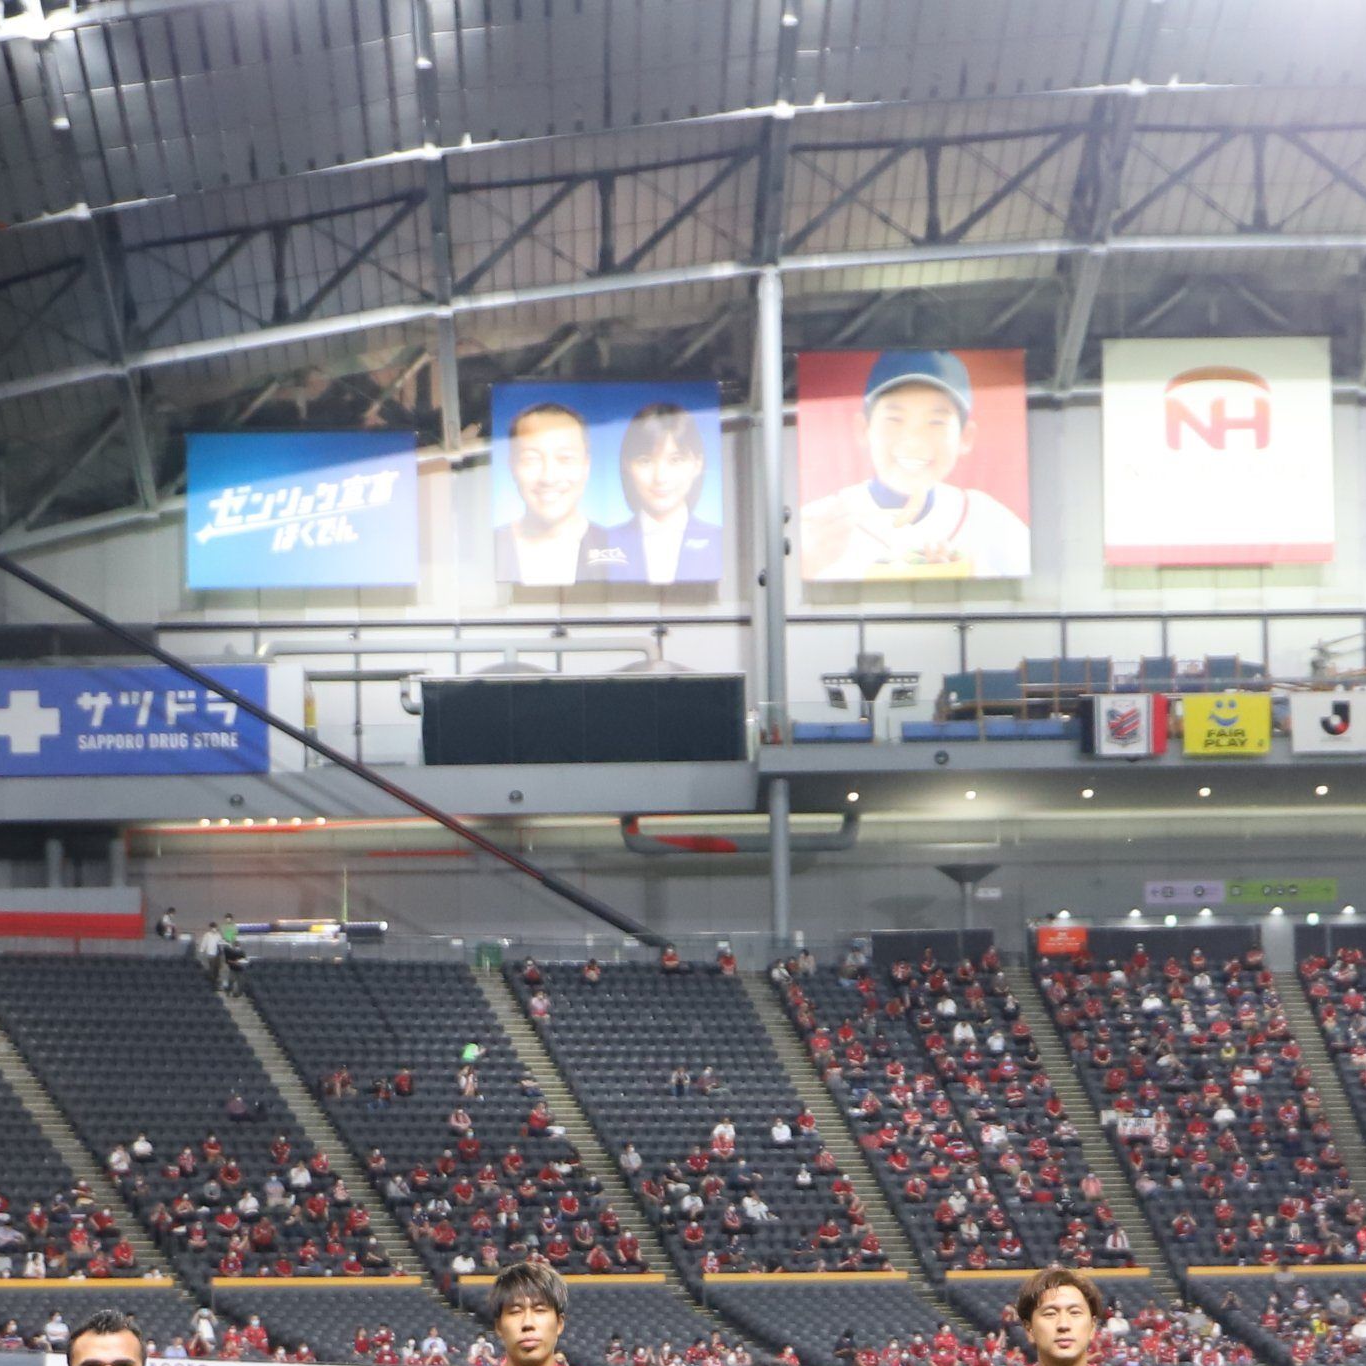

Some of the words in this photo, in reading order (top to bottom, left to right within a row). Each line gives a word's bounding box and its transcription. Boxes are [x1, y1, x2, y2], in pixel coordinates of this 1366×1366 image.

[77, 688, 239, 728] サツドラ
[78, 733, 145, 751] SAPPORO
[149, 732, 188, 749] DRUG
[193, 731, 239, 748] STORE
[1206, 728, 1246, 739] FAIR
[1204, 738, 1248, 749] PLAY
